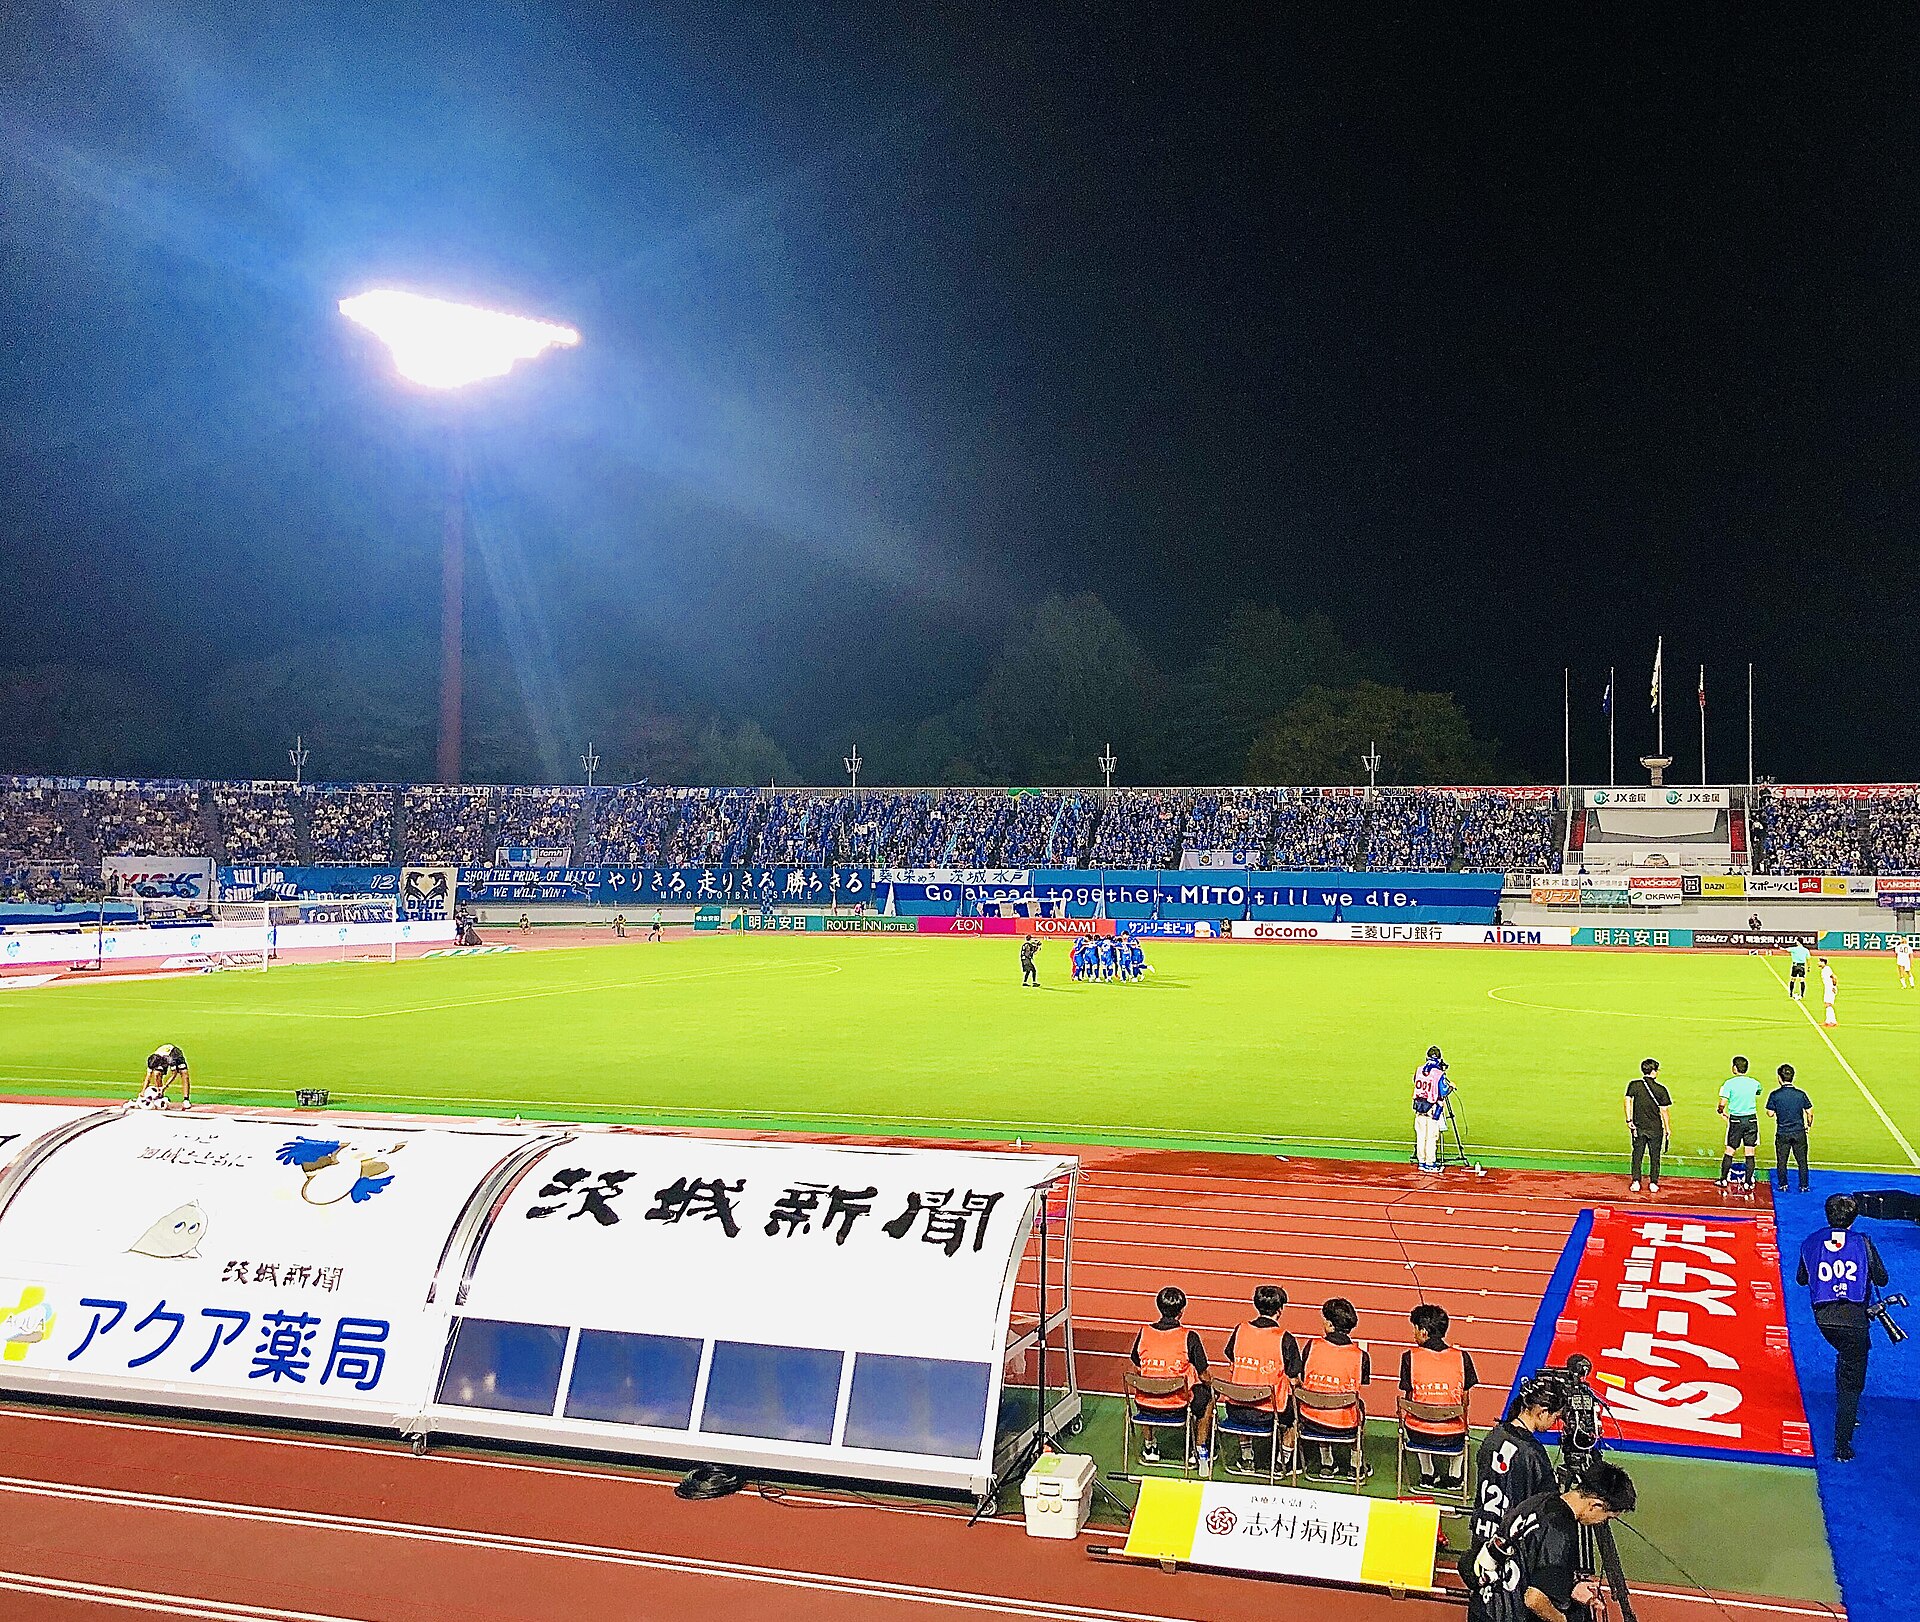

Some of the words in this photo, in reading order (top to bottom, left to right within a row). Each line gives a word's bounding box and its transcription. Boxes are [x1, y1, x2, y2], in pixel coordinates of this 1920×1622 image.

[1613, 793, 1646, 802] JX金属
[1687, 793, 1720, 802] JX金属
[262, 868, 284, 885] die
[370, 874, 395, 890] 12
[463, 870, 490, 881] SHOW
[492, 870, 510, 881] THE
[513, 870, 539, 881] PRIDE
[546, 870, 559, 881] OF
[563, 870, 596, 881] MITO
[607, 871, 687, 892] やりきる
[697, 871, 776, 894] 走りきる
[785, 871, 864, 893] 勝ちきる
[949, 869, 987, 883] 茨城
[992, 870, 1024, 882] 水戸
[492, 887, 508, 898] WE
[513, 887, 538, 898] WILL
[541, 887, 567, 898] WIN!
[1704, 883, 1725, 891] DAZN
[1749, 881, 1798, 891] スポーツくじ
[660, 890, 692, 900] MITO
[697, 890, 766, 900] FOOTBALL
[772, 890, 813, 900] STYLE
[925, 885, 953, 901] Go
[964, 886, 1034, 900] ahead
[1046, 886, 1160, 905] together
[1180, 886, 1245, 906] MITO
[1254, 890, 1309, 906] till
[1321, 891, 1353, 907] we
[1366, 891, 1407, 908] die
[1545, 890, 1578, 902] リーテム
[1645, 893, 1681, 901] OKAWA
[407, 899, 444, 910] BLUE
[308, 909, 338, 922] for
[748, 915, 806, 930] 明治安田
[826, 919, 861, 931] ROUTE
[883, 922, 915, 932] HOTELS
[1035, 920, 1097, 933] KONAMI
[1128, 920, 1194, 934] サントリー生ビール
[1253, 925, 1319, 939] docomo
[1350, 925, 1443, 941] 三菱UFJ銀行
[1594, 929, 1670, 946] 明治安田
[1695, 934, 1728, 943] 2026/27
[1843, 933, 1920, 951] 明治安田
[1415, 1079, 1432, 1092] 001
[525, 1167, 1006, 1258] 茨城新聞
[221, 1260, 344, 1293] 茨城新聞
[1817, 1259, 1858, 1282] 002
[67, 1296, 391, 1391] アクア薬局
[1242, 1511, 1361, 1548] 志村病院
